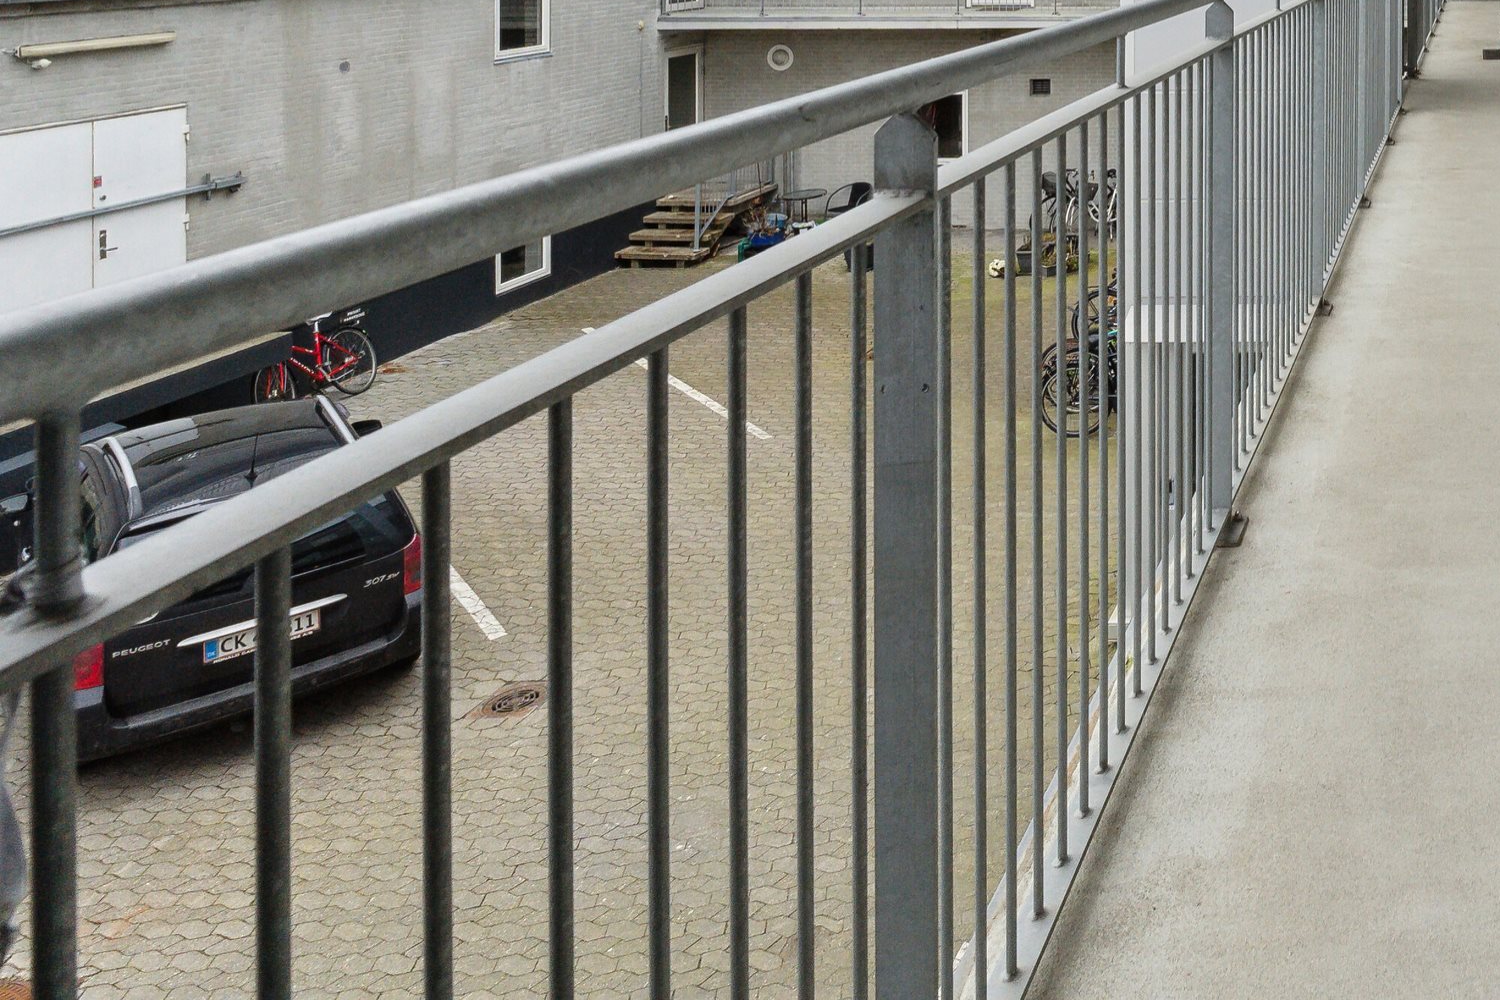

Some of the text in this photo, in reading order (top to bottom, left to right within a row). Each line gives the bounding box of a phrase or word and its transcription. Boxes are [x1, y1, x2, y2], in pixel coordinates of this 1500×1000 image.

[363, 574, 387, 588] 307
[112, 638, 172, 658] PEUGEOT
[220, 634, 247, 653] CK
